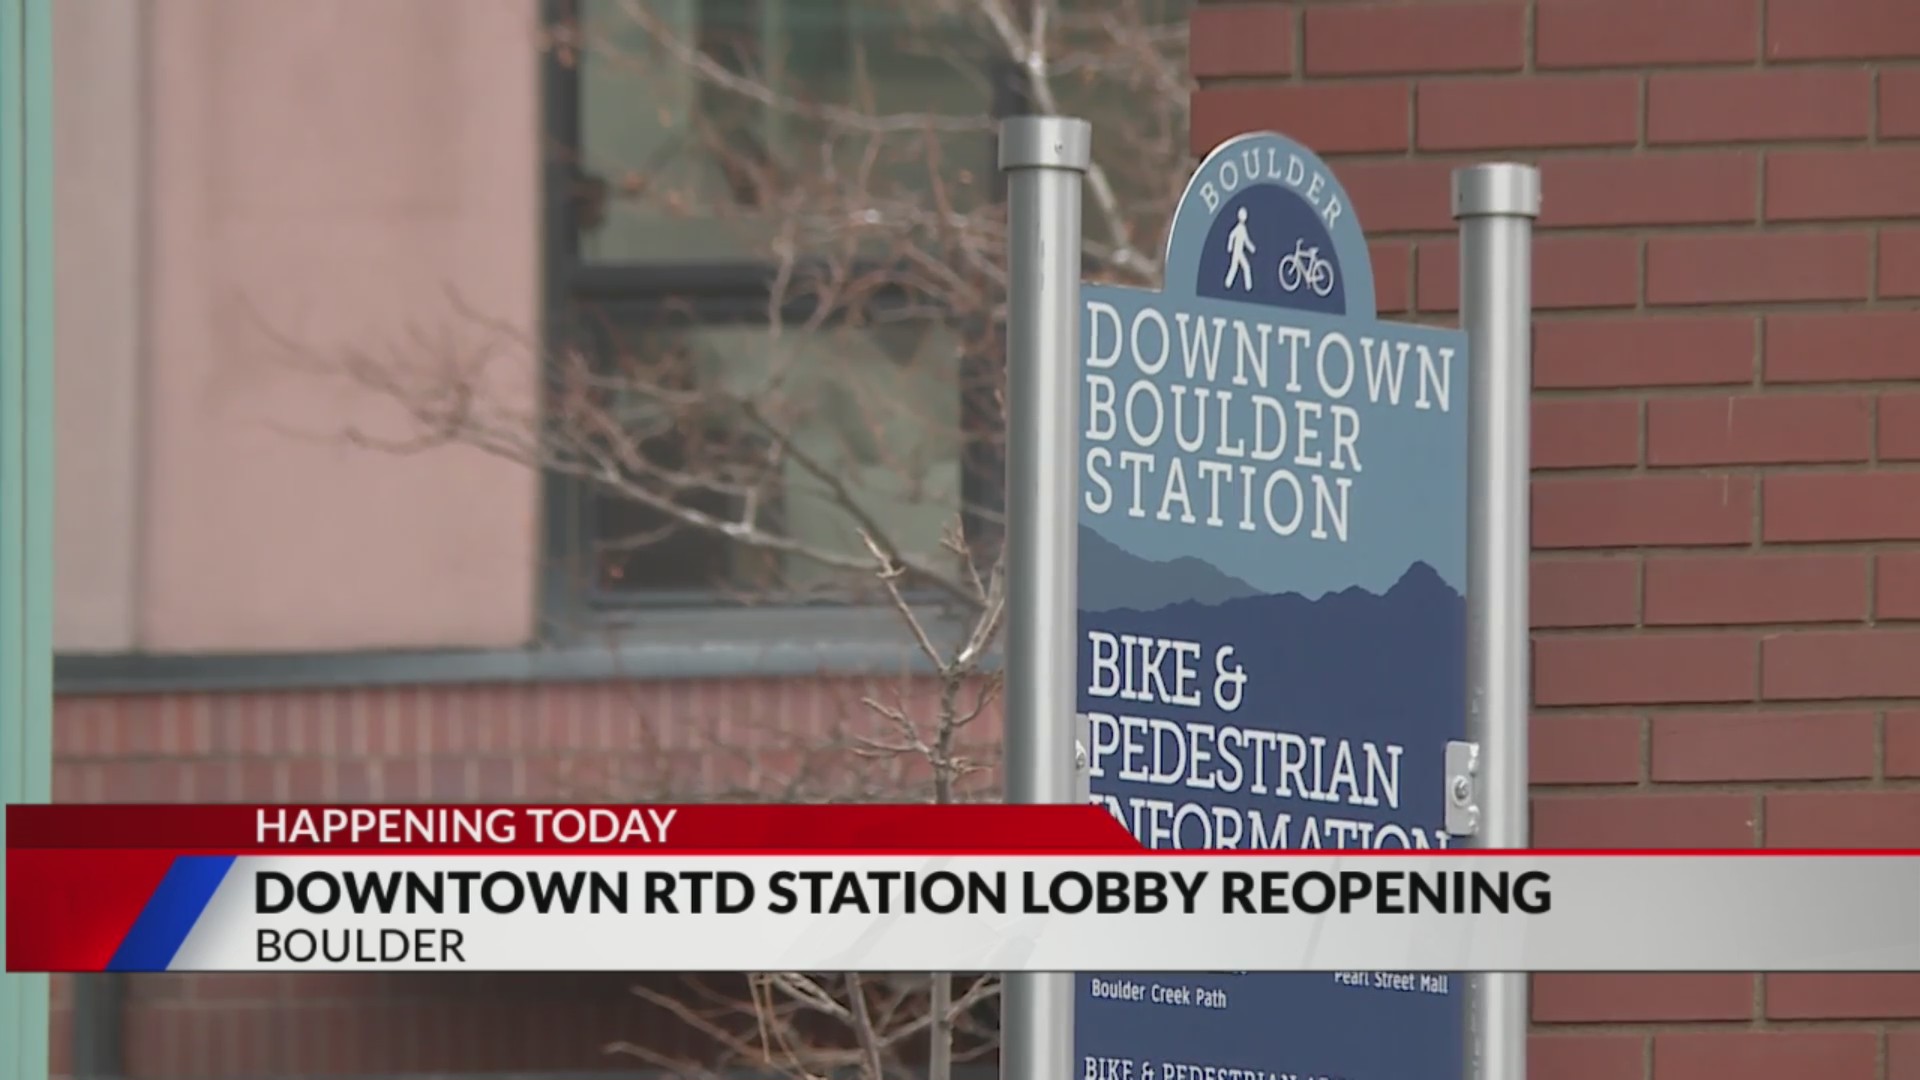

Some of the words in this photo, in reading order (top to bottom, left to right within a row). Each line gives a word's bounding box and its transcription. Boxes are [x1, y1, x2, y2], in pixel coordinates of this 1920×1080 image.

[1200, 147, 1342, 230] BOULDER
[1086, 301, 1454, 412] DOWNTOWN
[1085, 375, 1362, 472] BOULDER
[1085, 447, 1352, 541] STATION
[1088, 630, 1201, 706] BIKE
[1214, 645, 1248, 711] &
[1088, 712, 1403, 809] PEDESTRIAN
[1091, 978, 1146, 1001] Boulder
[1151, 984, 1190, 1005] Creek
[1196, 988, 1227, 1008] Path
[1374, 971, 1414, 991] Street
[1420, 973, 1448, 994] Mall
[1084, 1056, 1133, 1080] BIKE
[1141, 1061, 1155, 1080] &
